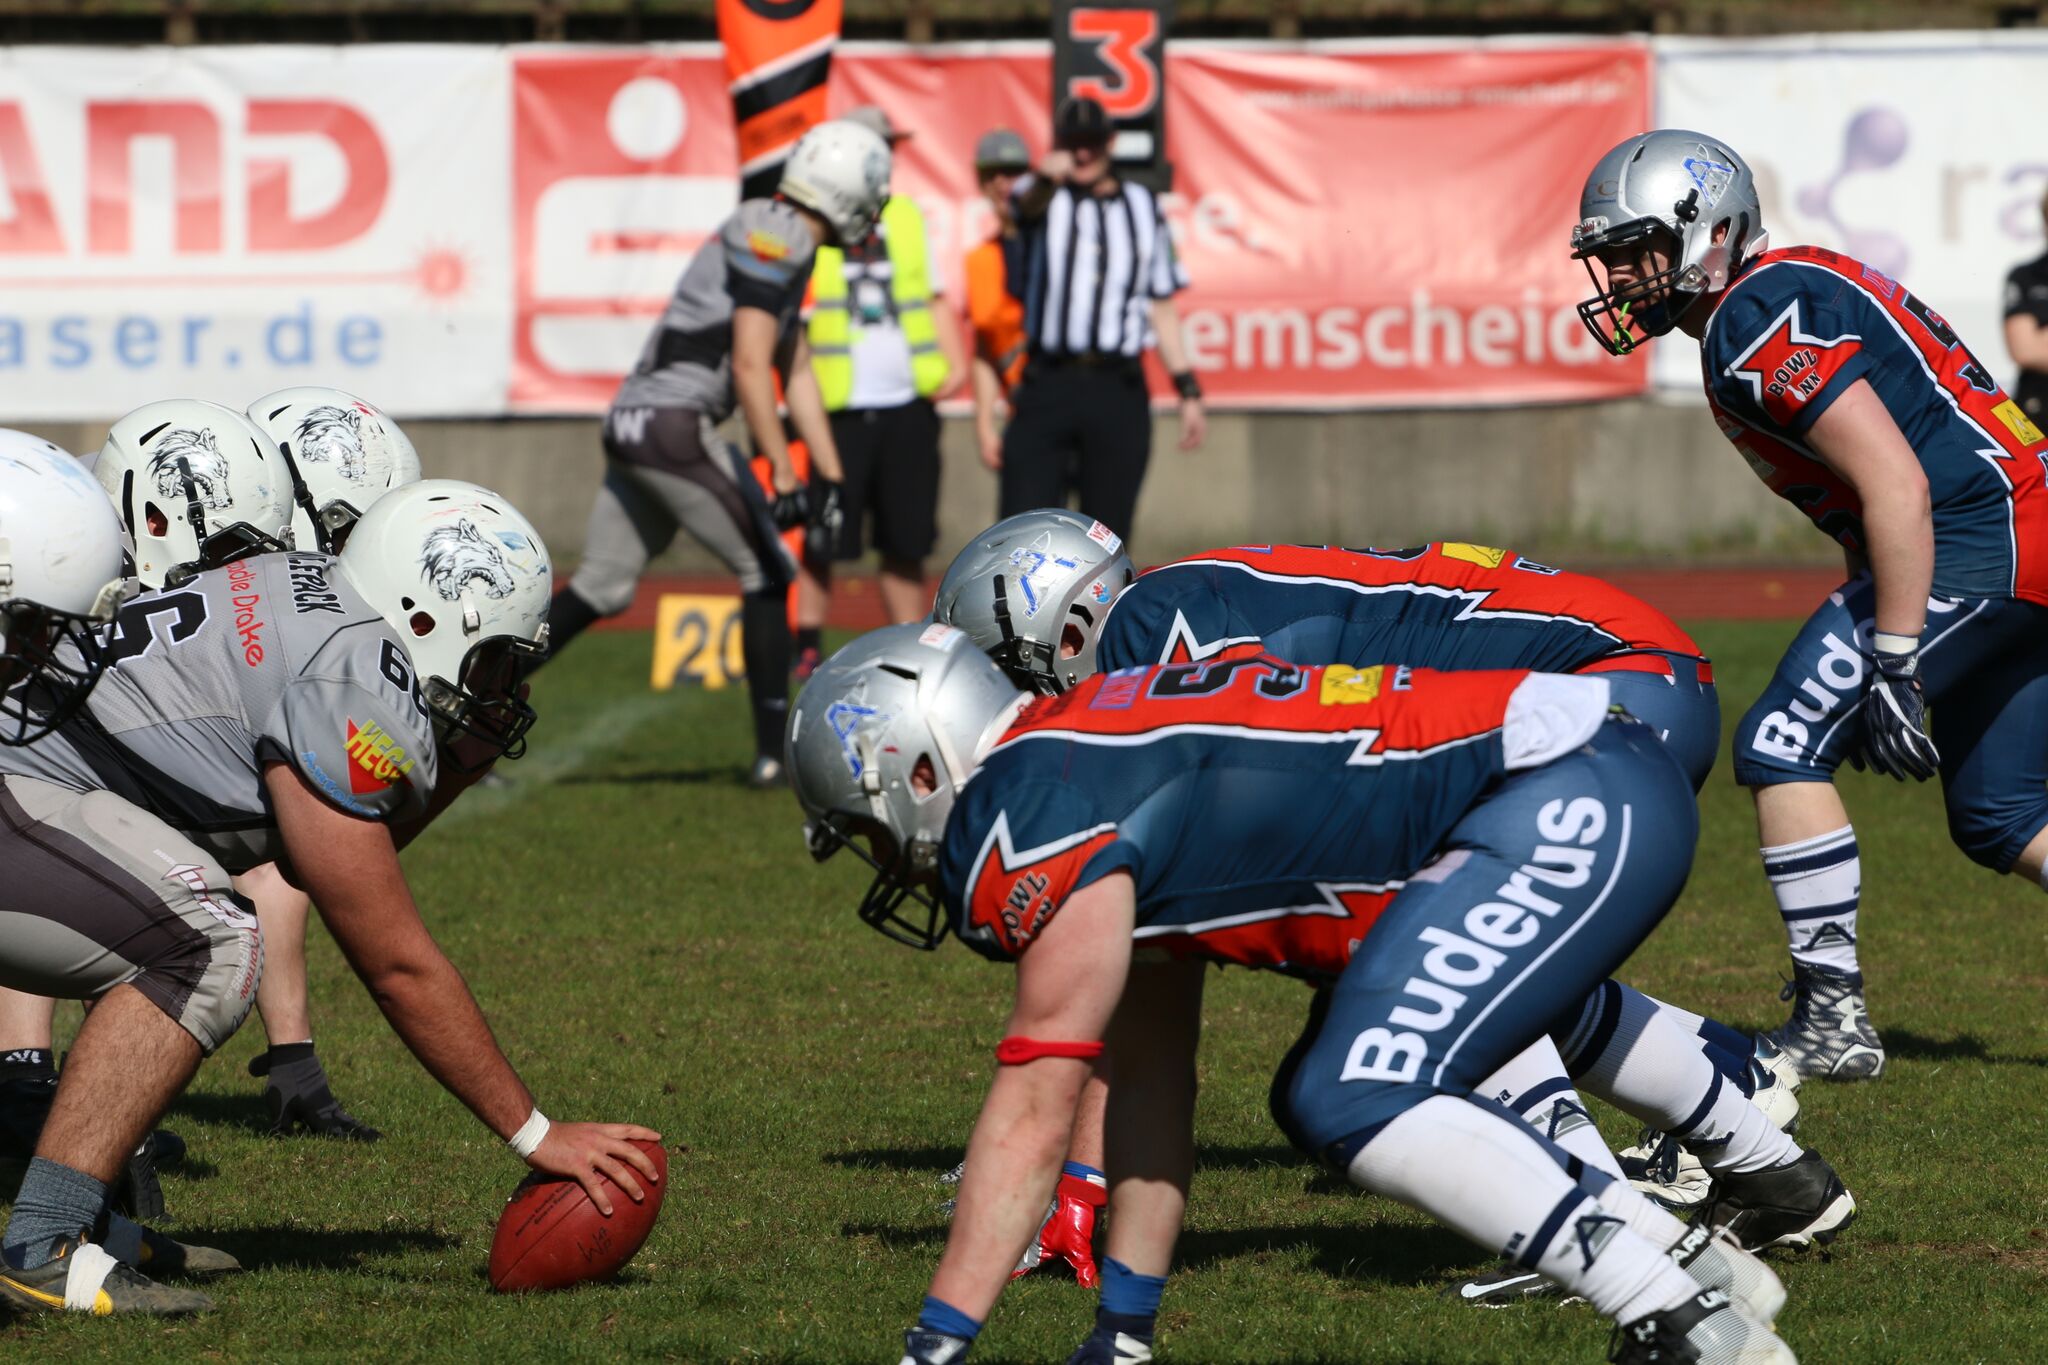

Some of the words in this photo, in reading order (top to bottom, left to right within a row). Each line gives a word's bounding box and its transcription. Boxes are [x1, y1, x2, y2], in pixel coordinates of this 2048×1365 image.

[1069, 9, 1160, 118] 3
[1766, 348, 1819, 398] BOWL
[231, 593, 265, 668] Drake
[674, 609, 748, 684] 20
[1340, 796, 1608, 1084] Buderus
